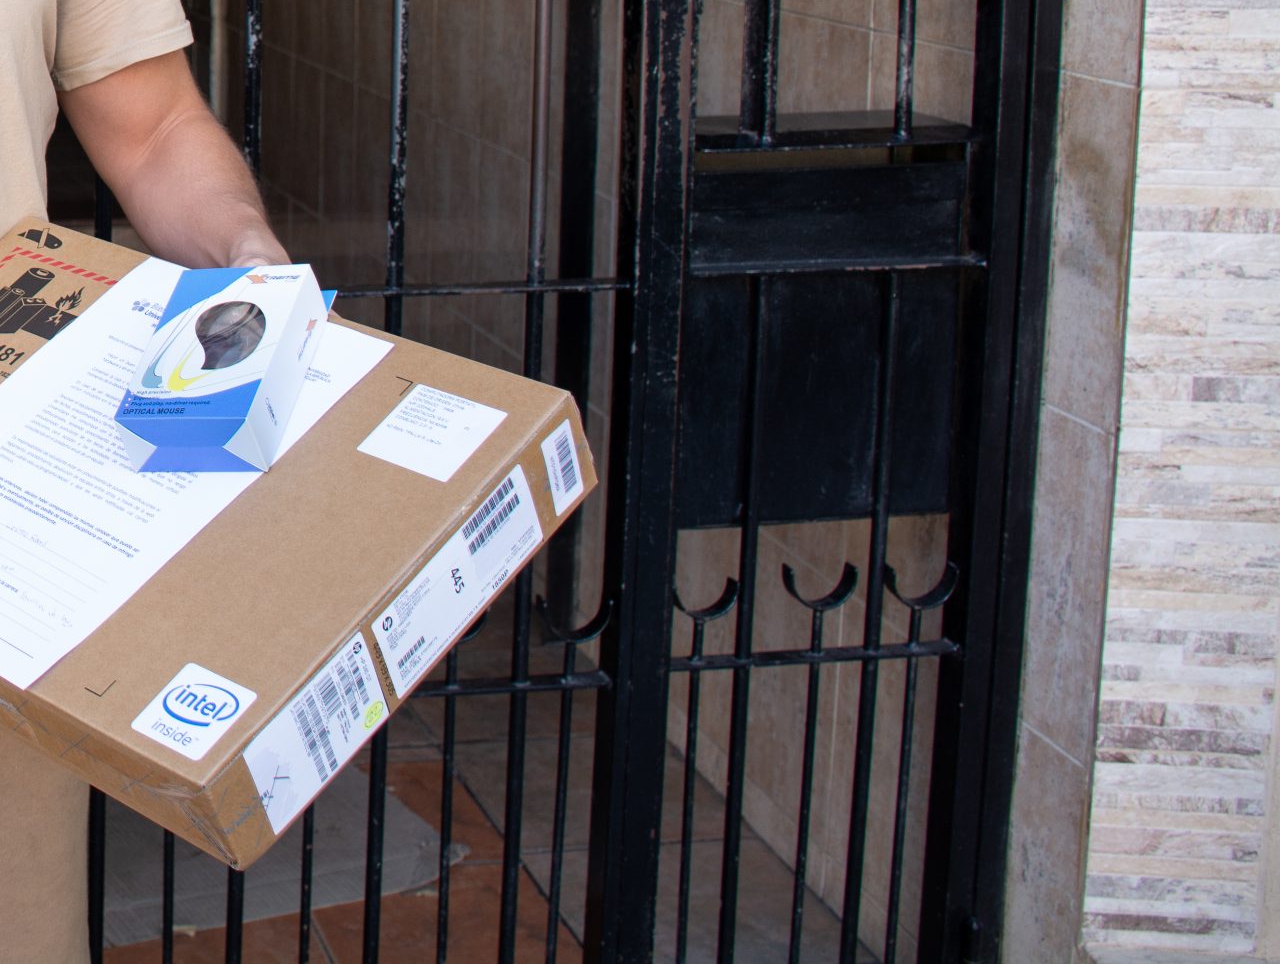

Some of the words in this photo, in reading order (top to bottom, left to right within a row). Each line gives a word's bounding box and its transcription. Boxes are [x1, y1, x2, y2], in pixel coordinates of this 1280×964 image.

[451, 567, 465, 594] 445
[174, 684, 228, 720] intel
[151, 718, 193, 747] inside
